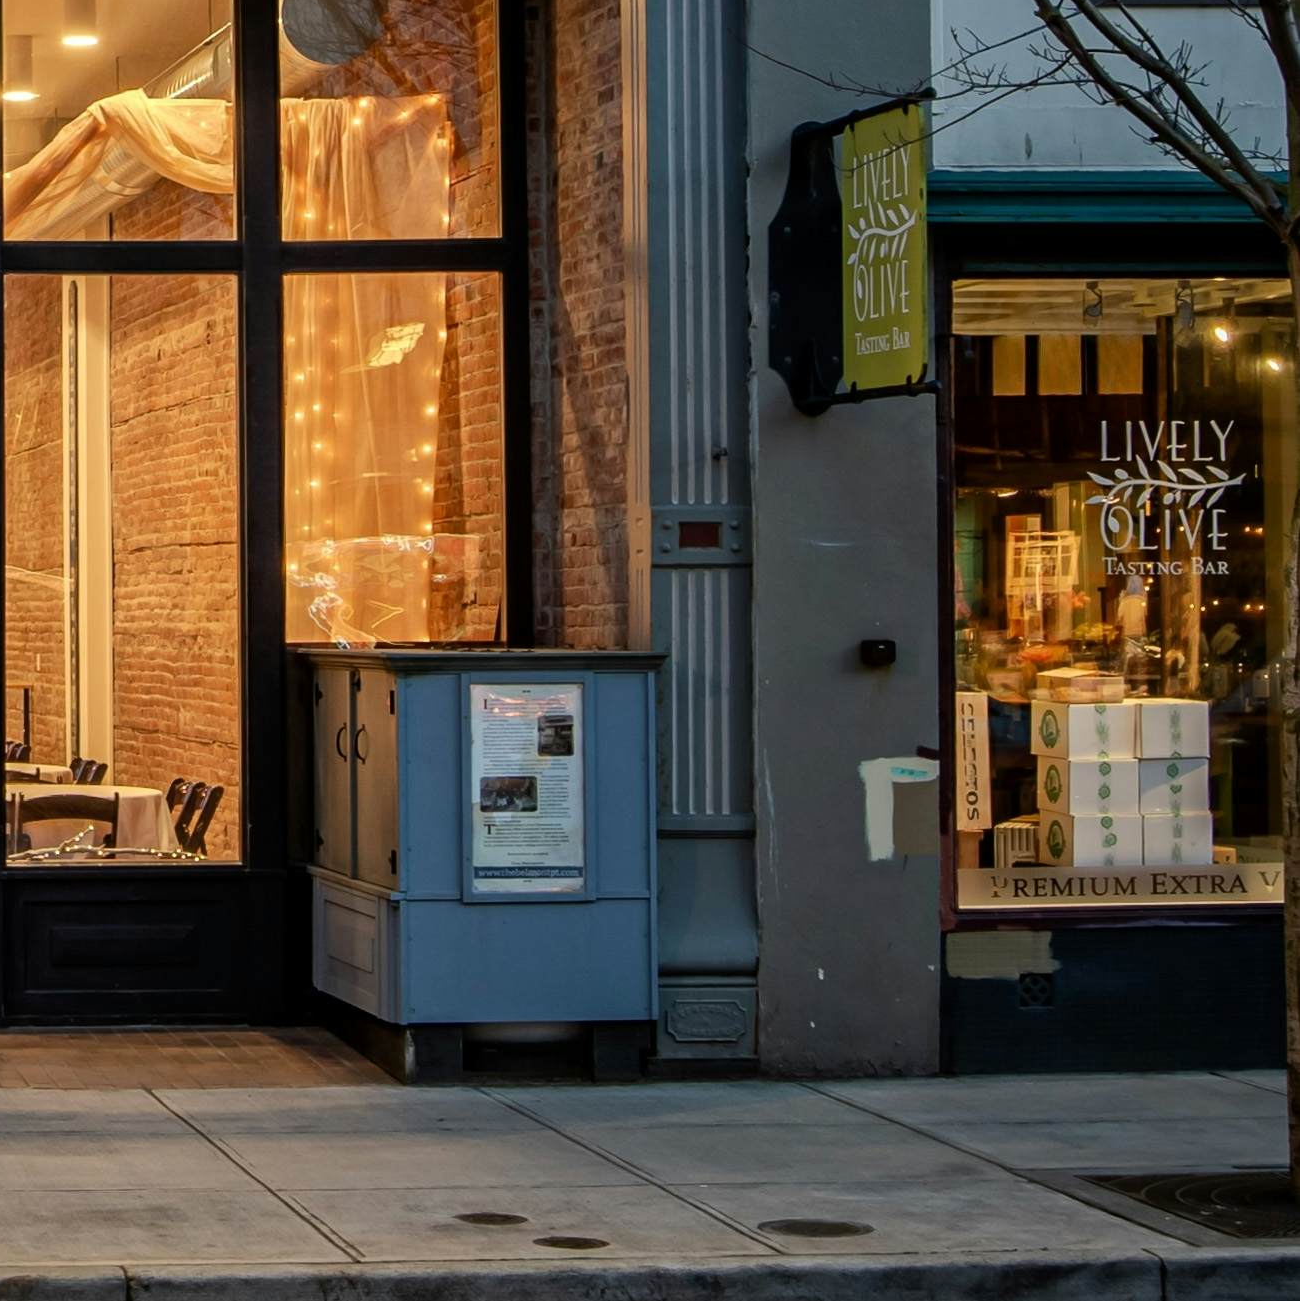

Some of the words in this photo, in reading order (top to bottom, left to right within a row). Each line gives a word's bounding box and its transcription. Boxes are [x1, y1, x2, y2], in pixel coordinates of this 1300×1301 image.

[852, 144, 912, 209] LIVELY
[853, 260, 911, 323] OLIVE
[1100, 419, 1235, 462] LIVELY
[1099, 505, 1229, 551] OLIVE
[1102, 556, 1184, 576] TASTING
[1190, 556, 1230, 575] BAR
[990, 874, 1138, 898] PREMIUM
[1150, 872, 1248, 896] EXTRA
